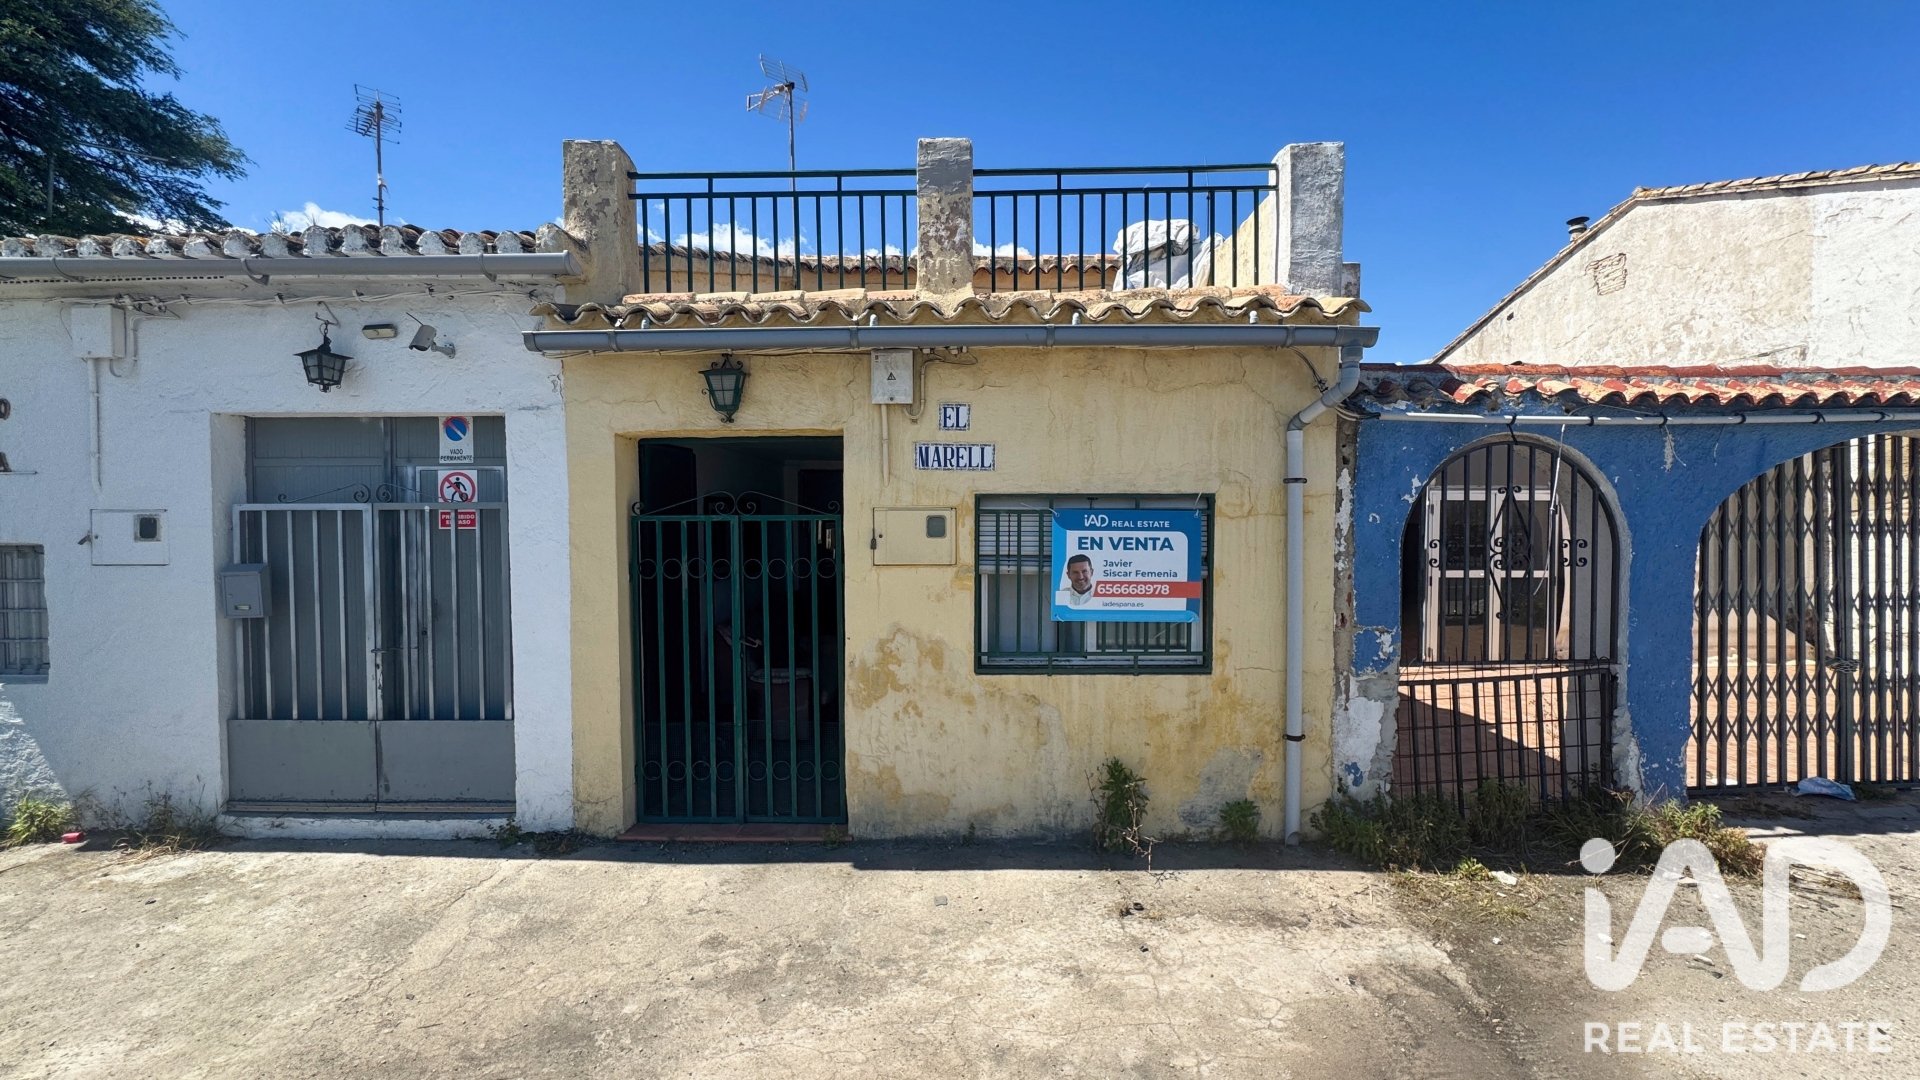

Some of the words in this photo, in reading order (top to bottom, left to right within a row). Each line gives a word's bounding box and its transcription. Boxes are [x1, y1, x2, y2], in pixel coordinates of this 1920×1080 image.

[943, 406, 967, 428] EL
[918, 446, 991, 468] MARELL
[1111, 520, 1135, 528] REAL
[1137, 520, 1170, 528] ESTATE
[1077, 536, 1104, 550] EN
[1109, 536, 1175, 551] VENTA
[1103, 559, 1133, 568] Javier
[1103, 569, 1132, 578] Siscar
[1135, 569, 1178, 578] Femenia
[1097, 583, 1170, 595] 656668978
